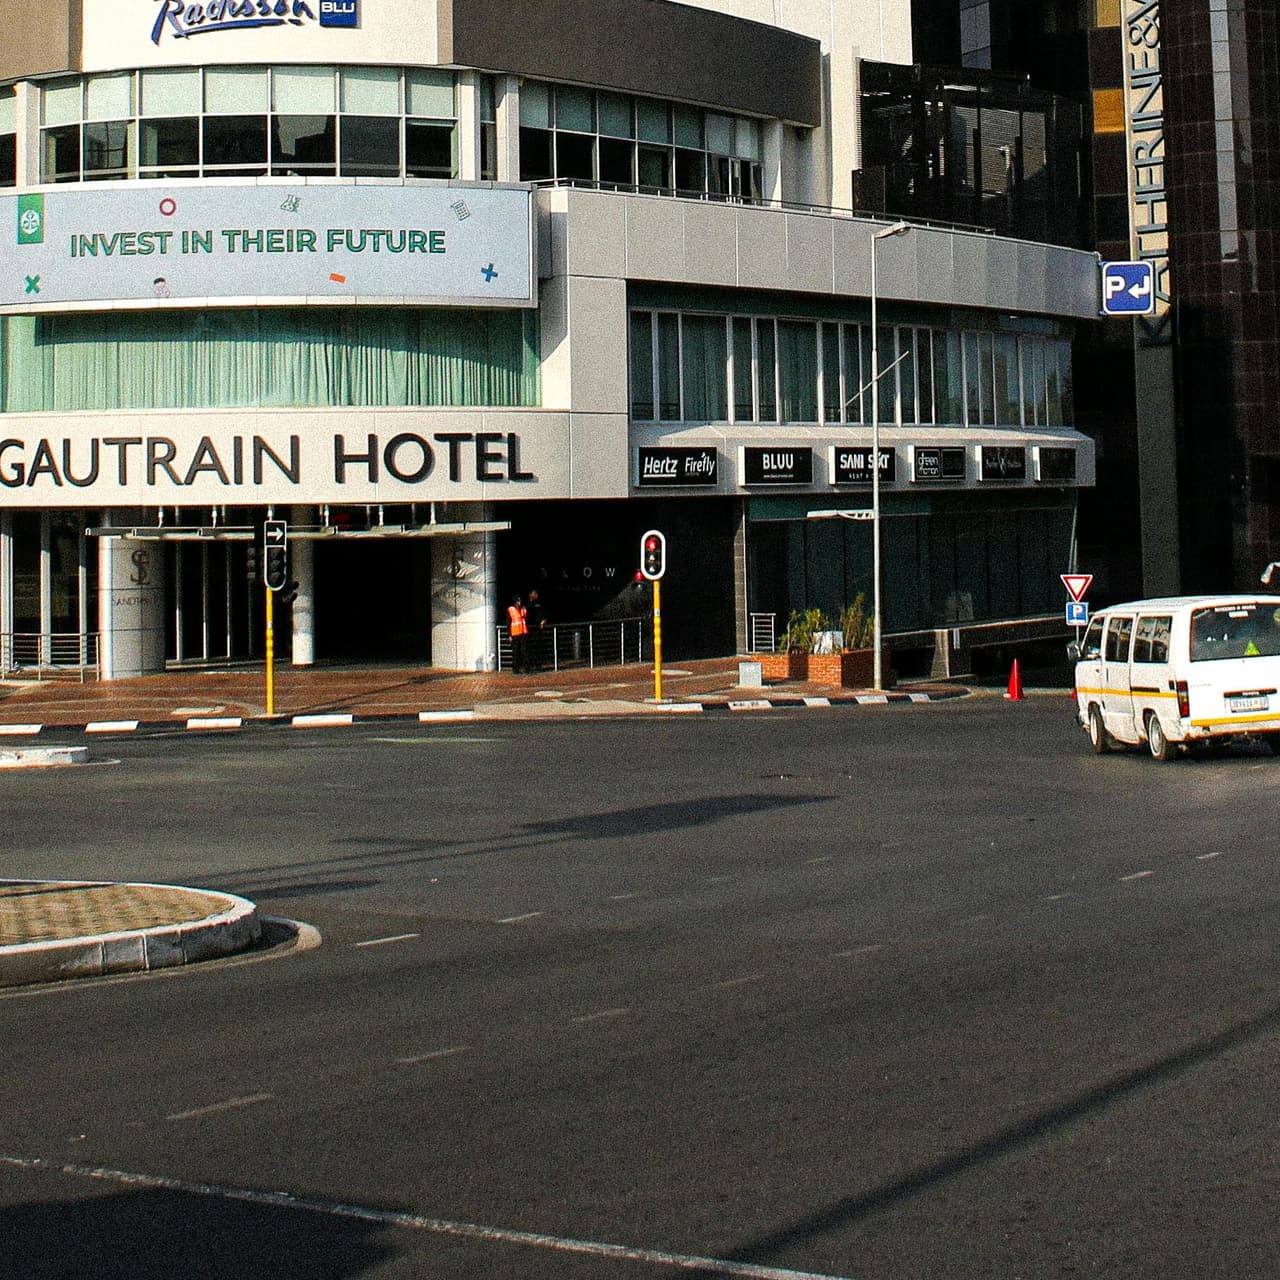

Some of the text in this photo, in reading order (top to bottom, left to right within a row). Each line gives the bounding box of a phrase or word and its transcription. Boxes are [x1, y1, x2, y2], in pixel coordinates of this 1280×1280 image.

[320, 1, 356, 14] BLU
[70, 229, 446, 257] INVEST IN THEIR FUTURE
[333, 431, 538, 485] HOTEL
[644, 456, 678, 474] Hertz
[684, 451, 715, 476] Firefly
[762, 453, 794, 470] BLUU
[840, 453, 864, 469] SANI
